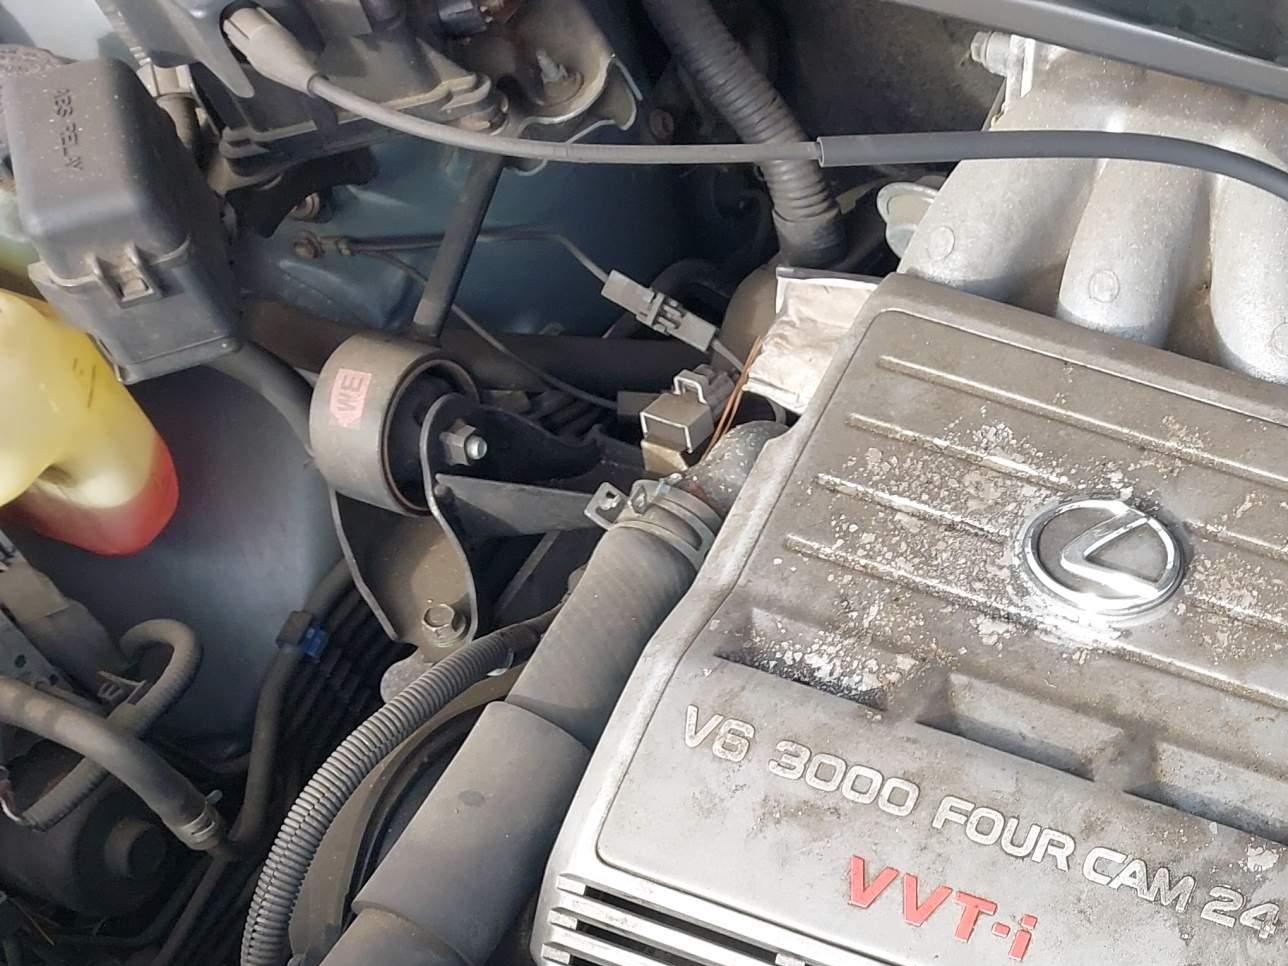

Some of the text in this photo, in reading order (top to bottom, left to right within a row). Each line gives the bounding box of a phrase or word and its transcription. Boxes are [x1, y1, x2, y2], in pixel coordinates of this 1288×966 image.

[684, 704, 1283, 939] V6 3000 FOUR CAM 24
[848, 855, 1038, 961] VVT-i
